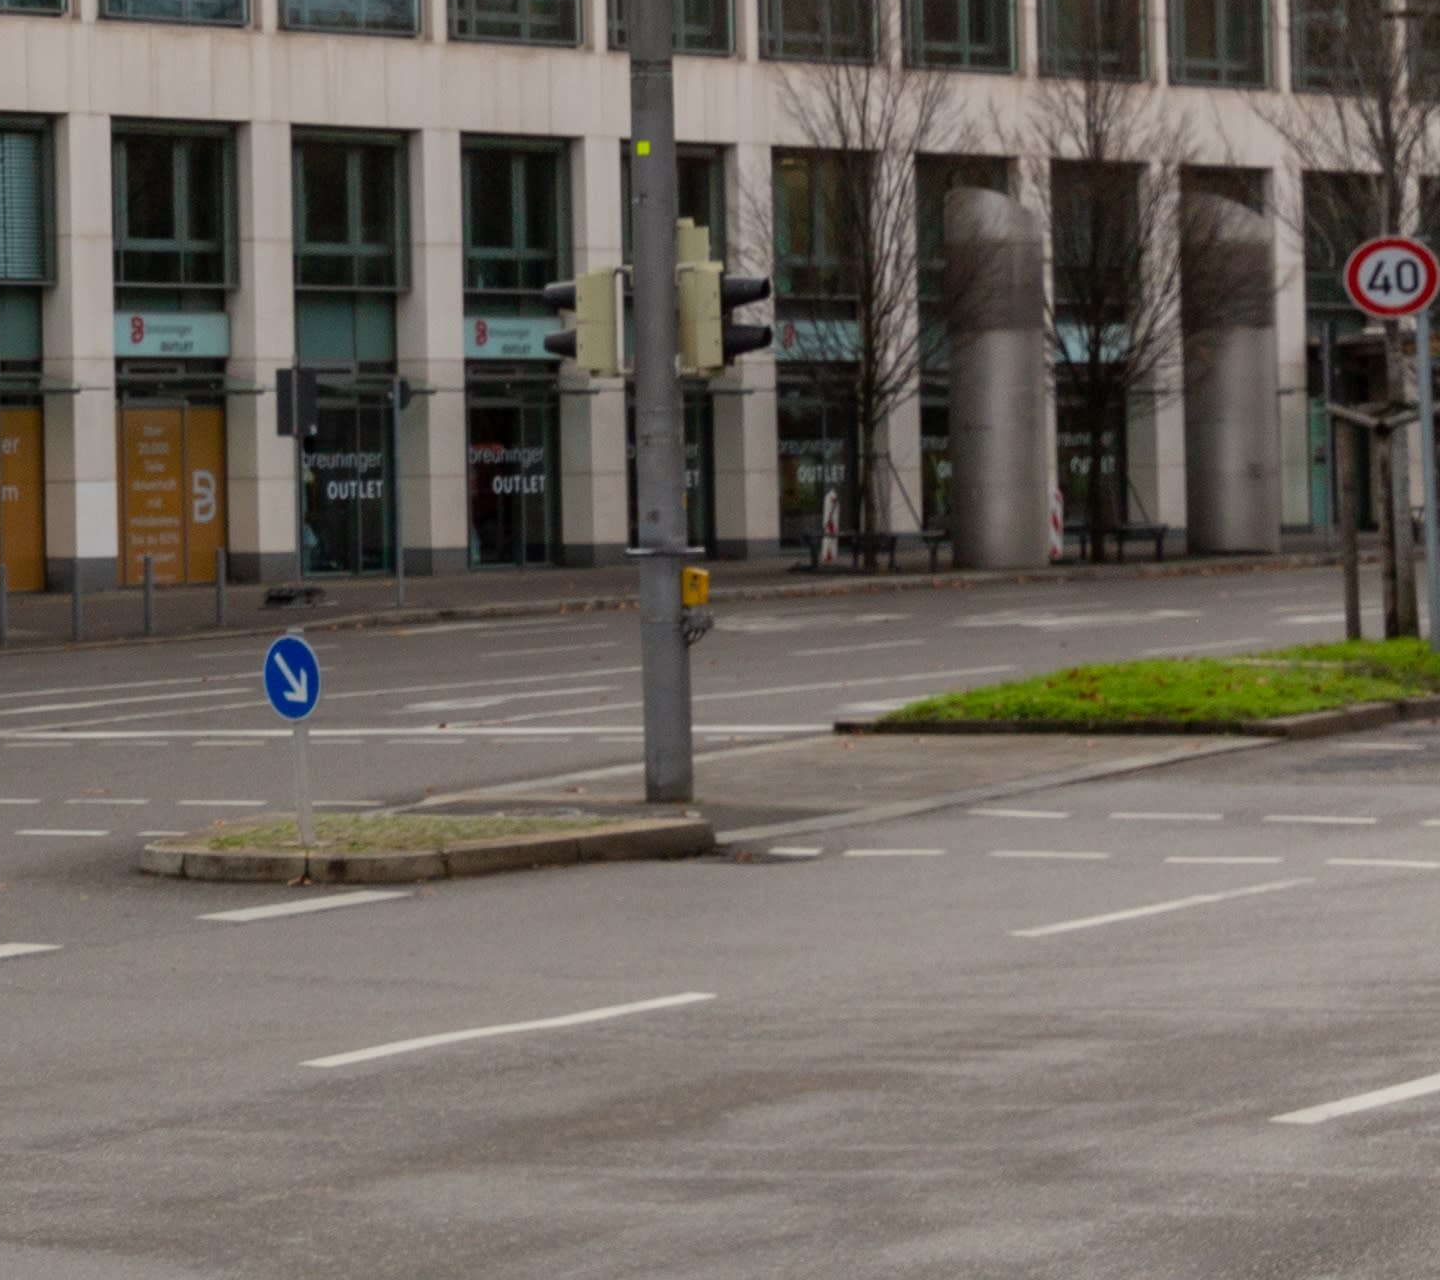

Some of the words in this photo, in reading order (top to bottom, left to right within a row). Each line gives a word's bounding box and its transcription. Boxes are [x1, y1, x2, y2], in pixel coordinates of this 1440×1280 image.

[1367, 258, 1420, 296] 40
[301, 450, 383, 473] breuninger
[468, 445, 546, 470] breuninger
[492, 474, 547, 495] OUTLET
[796, 463, 847, 484] OUTLET
[327, 479, 384, 501] OUTLET
